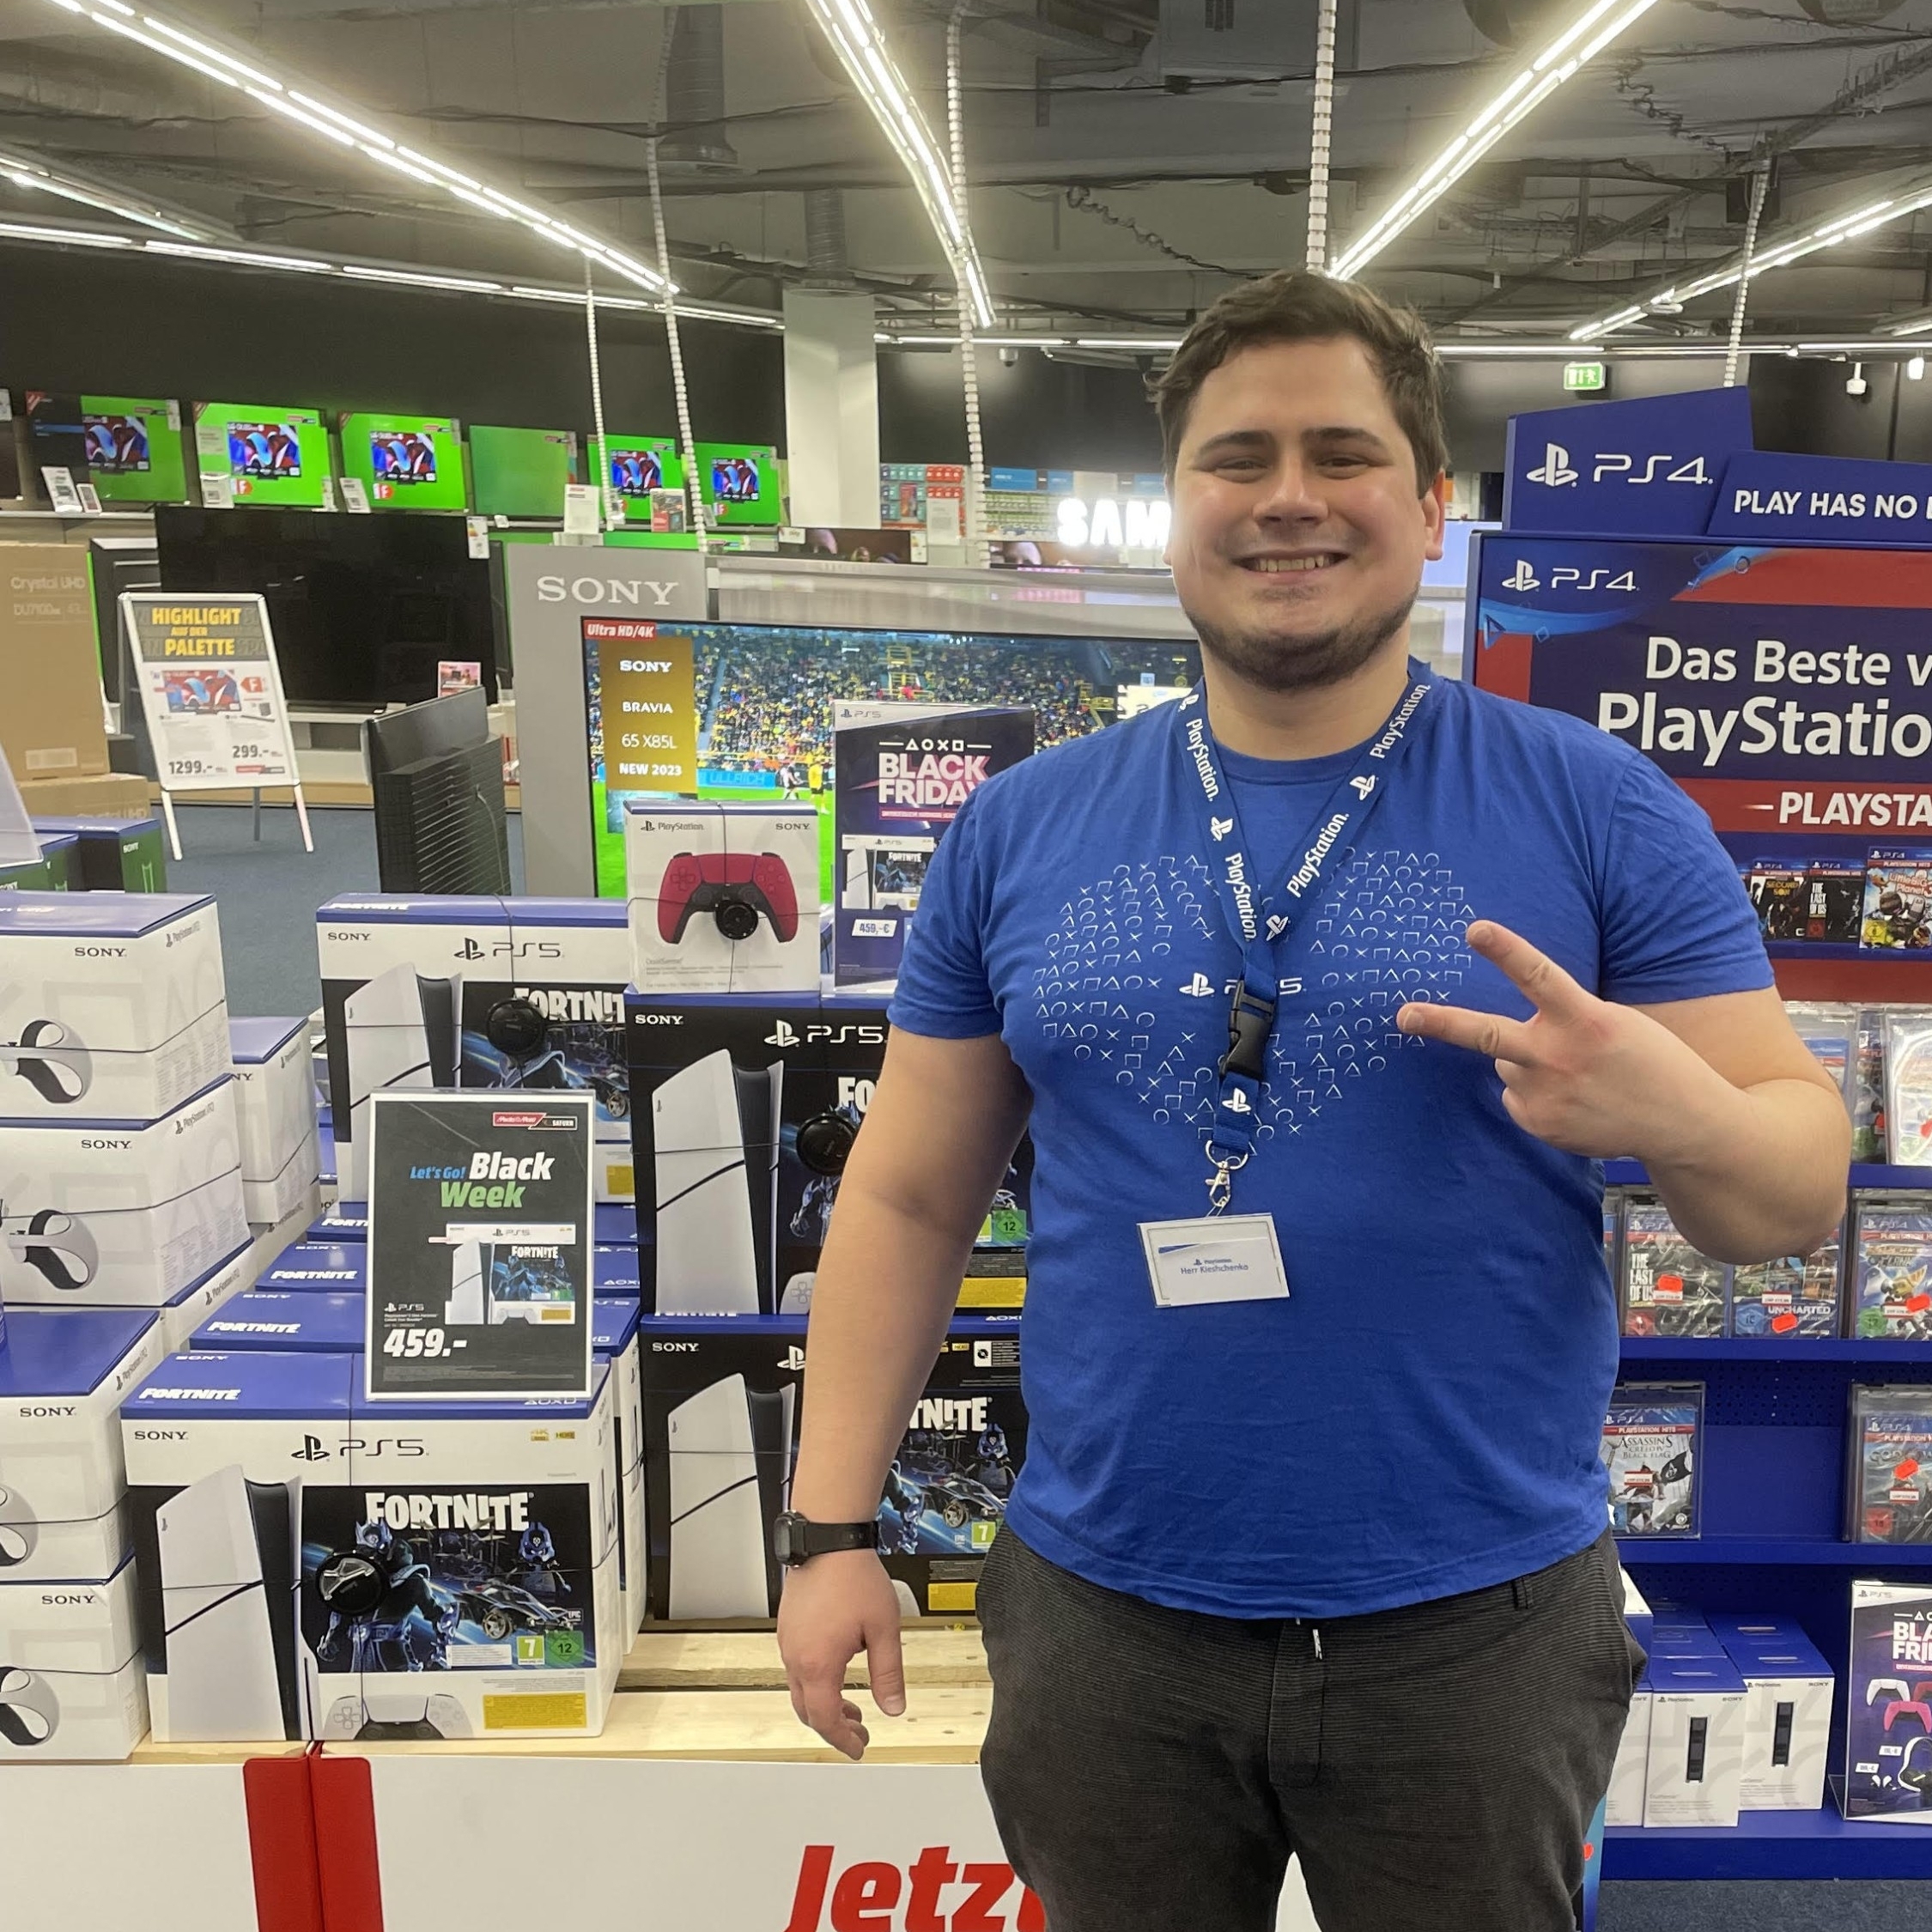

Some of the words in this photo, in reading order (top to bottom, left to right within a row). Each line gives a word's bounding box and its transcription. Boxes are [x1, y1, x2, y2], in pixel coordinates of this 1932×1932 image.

[1594, 454, 1708, 484] PS4
[1735, 489, 1801, 515] PLAY
[1809, 492, 1867, 518] HAS
[1874, 495, 1918, 519] NO
[1552, 568, 1636, 591] PS4
[537, 575, 679, 605] SONY
[151, 607, 241, 625] HIGHLIGHT
[189, 627, 208, 636] DER
[587, 623, 616, 636] Ultra
[617, 624, 655, 638] HD/4K
[165, 638, 235, 656] PALETTE
[619, 659, 672, 672] SONY
[1646, 635, 1736, 682] Das
[1753, 639, 1892, 687] Beste
[622, 701, 673, 714] BRAVIA
[854, 710, 881, 719] PS5
[1369, 683, 1430, 759] PlayStation
[1597, 692, 1932, 767] PlayStatio
[621, 733, 640, 749] 65
[642, 733, 677, 750] X85L
[878, 752, 990, 781] BLACK
[1186, 718, 1220, 801] PlayStation
[619, 762, 648, 775] NEW
[651, 763, 683, 776] 2023
[658, 821, 704, 832] PlayStation
[1287, 812, 1349, 898] PlayStation
[1224, 852, 1257, 940] PlayStation
[328, 932, 371, 941] SONY
[75, 947, 126, 957] SONY
[492, 943, 562, 958] PS5
[635, 1014, 683, 1025] SONY
[806, 1024, 884, 1044] PS5
[81, 1139, 131, 1149] SONY
[410, 1165, 441, 1180] Let's
[442, 1165, 465, 1180] Go!
[469, 1151, 556, 1181] Black
[440, 1182, 526, 1209] Week
[1003, 1222, 1016, 1231] 12
[511, 1245, 559, 1260] FORTNITE
[1631, 1253, 1649, 1269] THE
[270, 1270, 358, 1280] FORTNITE
[1630, 1269, 1655, 1285] LAST
[398, 1303, 425, 1311] PS5
[1767, 1305, 1831, 1315] UNCHARTED
[207, 1321, 301, 1334] FORTNITE
[383, 1327, 468, 1358] 459.-
[652, 1342, 700, 1352] SONY
[138, 1388, 241, 1400] FORTNITE
[20, 1406, 76, 1417] SONY
[134, 1431, 187, 1440] SONY
[339, 1438, 426, 1456] PS5
[365, 1492, 530, 1532] FORTNITE
[979, 1524, 988, 1541] 7
[41, 1595, 95, 1605] SONY
[524, 1638, 537, 1657] 7
[558, 1643, 572, 1654] 12
